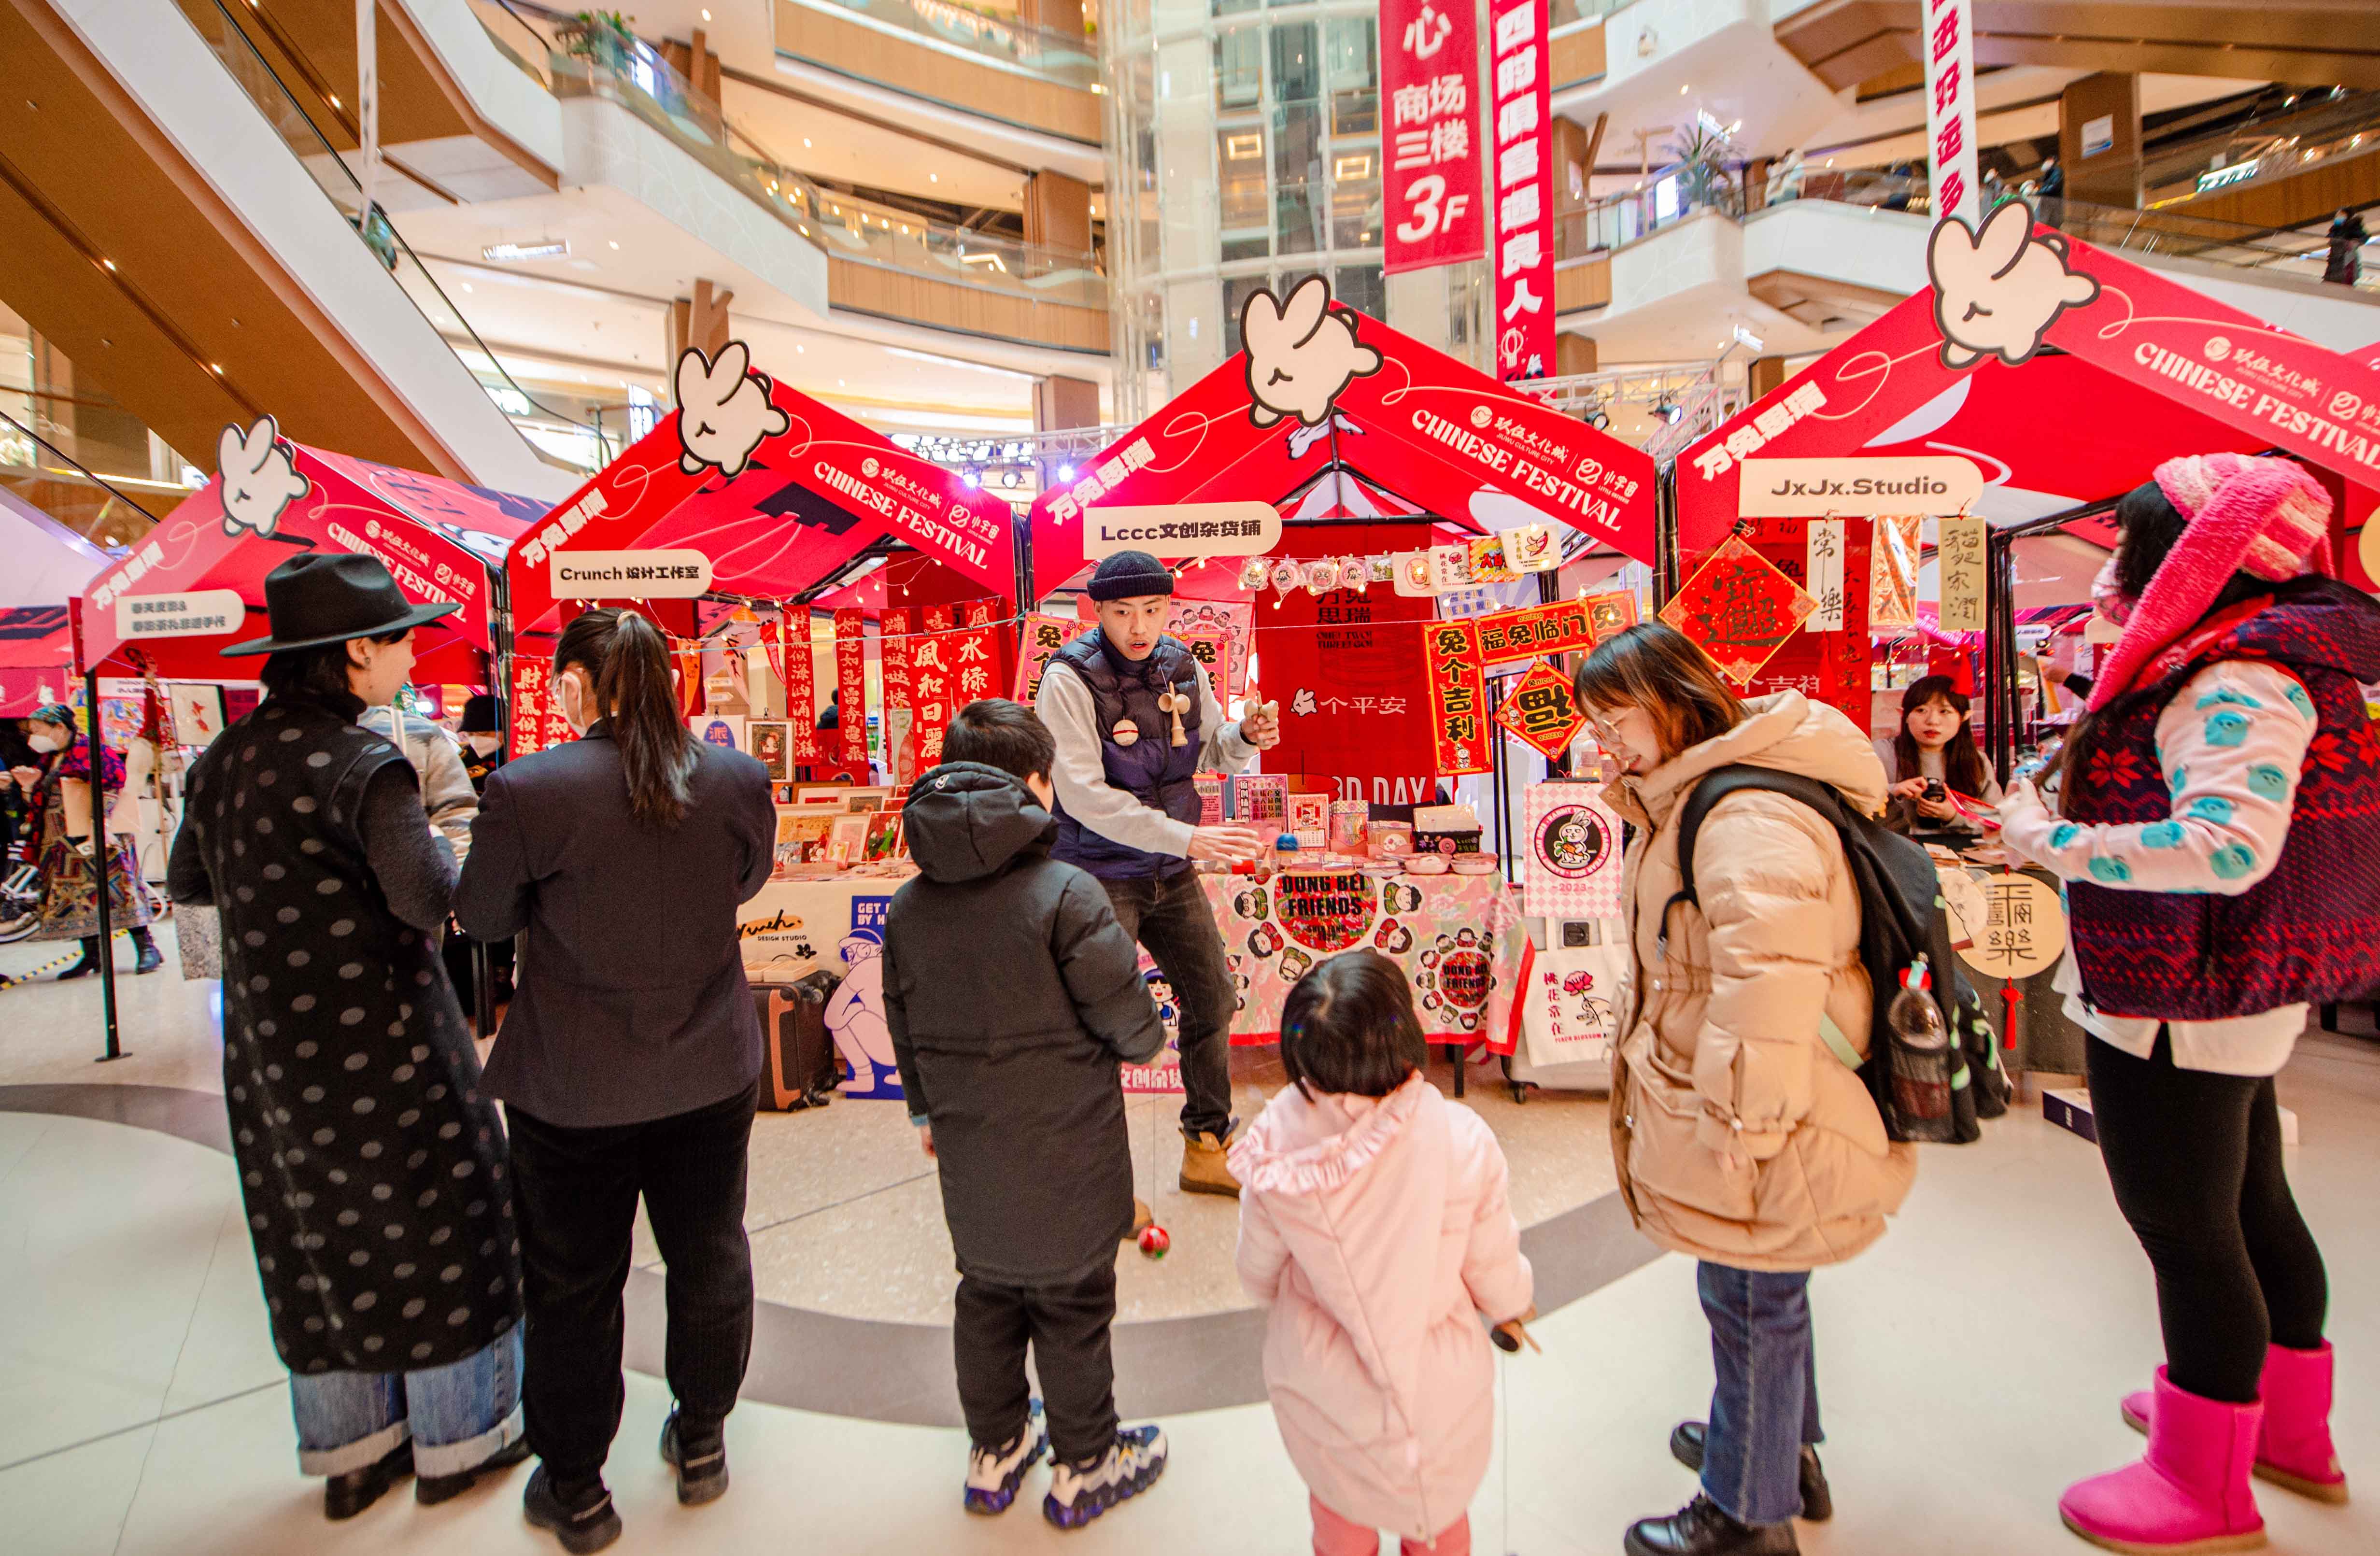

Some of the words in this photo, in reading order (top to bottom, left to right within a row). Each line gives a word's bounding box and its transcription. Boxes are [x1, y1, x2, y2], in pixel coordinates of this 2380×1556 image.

[1393, 73, 1467, 127] 商场
[1394, 118, 1469, 172] 三楼
[1397, 174, 1469, 243] 3F
[2134, 341, 2256, 410] CHINESE
[2252, 393, 2380, 469] FESTIVAL
[1514, 440, 1542, 459] CULTURE
[1540, 454, 1555, 465] CITY
[1411, 409, 1514, 474] CHINESE
[1510, 458, 1622, 533] FESTIVAL
[1771, 475, 1948, 496] JxJx.Studio
[814, 460, 898, 518] CHINESE
[896, 504, 988, 570] FESTIVAL
[1101, 519, 1261, 541] Lccc文创杂货铺
[560, 566, 623, 580] Crunch
[626, 566, 699, 580] 设计工作室
[1316, 607, 1372, 624] 思瑞
[1593, 603, 1624, 641] 兔
[1317, 640, 1351, 650] THREE!
[1353, 639, 1372, 649] GO!
[1346, 631, 1372, 639] TWO!
[1481, 615, 1587, 652] 福兔临门
[1437, 628, 1474, 742] 兔个吉利
[1319, 696, 1407, 715] 个平安
[1517, 683, 1573, 733] 福
[1373, 776, 1427, 807] DAY
[1336, 874, 1365, 891] BEI
[857, 903, 881, 914] GET
[1288, 896, 1362, 917] FRIENDS
[857, 914, 873, 925] BY
